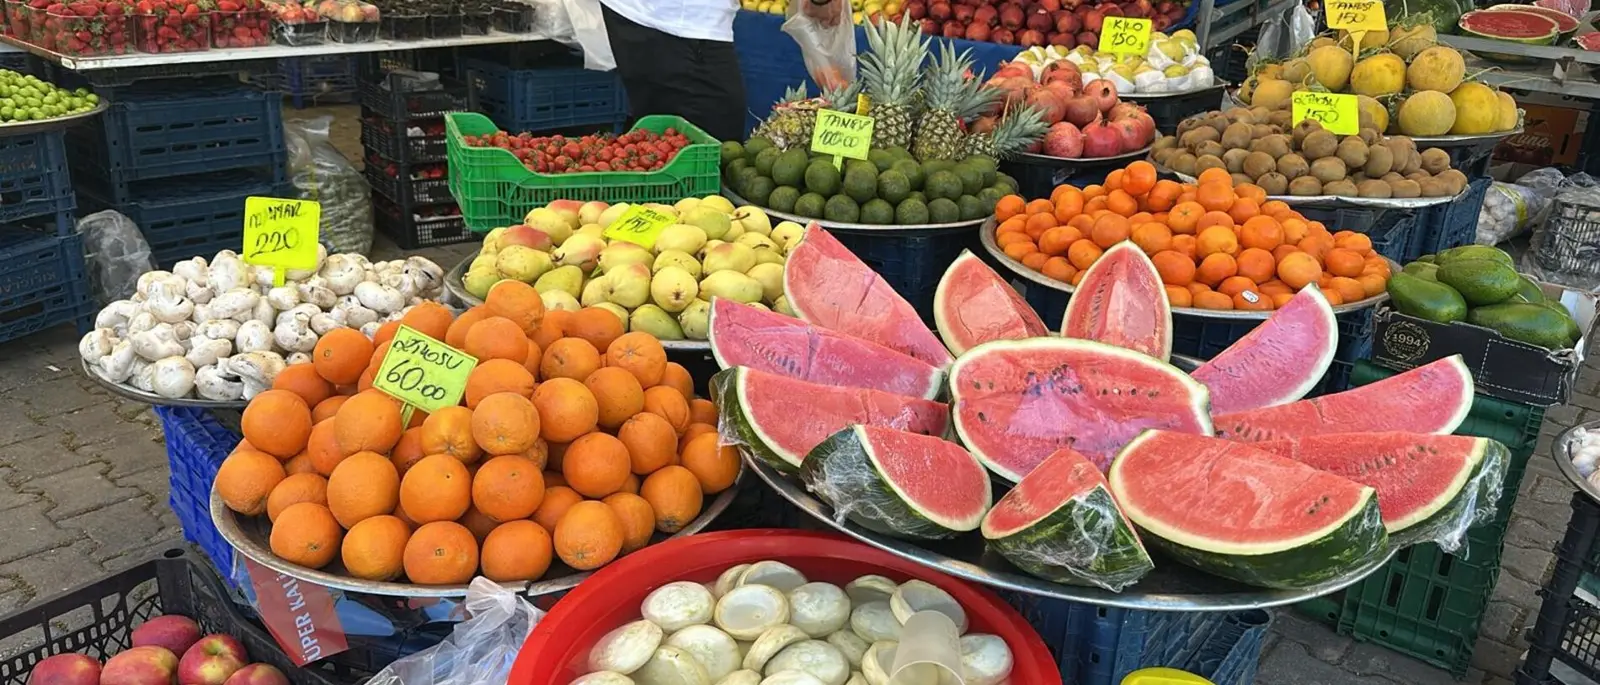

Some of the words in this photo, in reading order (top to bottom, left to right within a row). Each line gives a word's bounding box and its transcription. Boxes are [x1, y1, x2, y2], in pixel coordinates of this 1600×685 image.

[1336, 12, 1367, 25] 150
[249, 227, 300, 258] 220
[1391, 333, 1421, 347] 1994
[386, 359, 446, 400] 60.00
